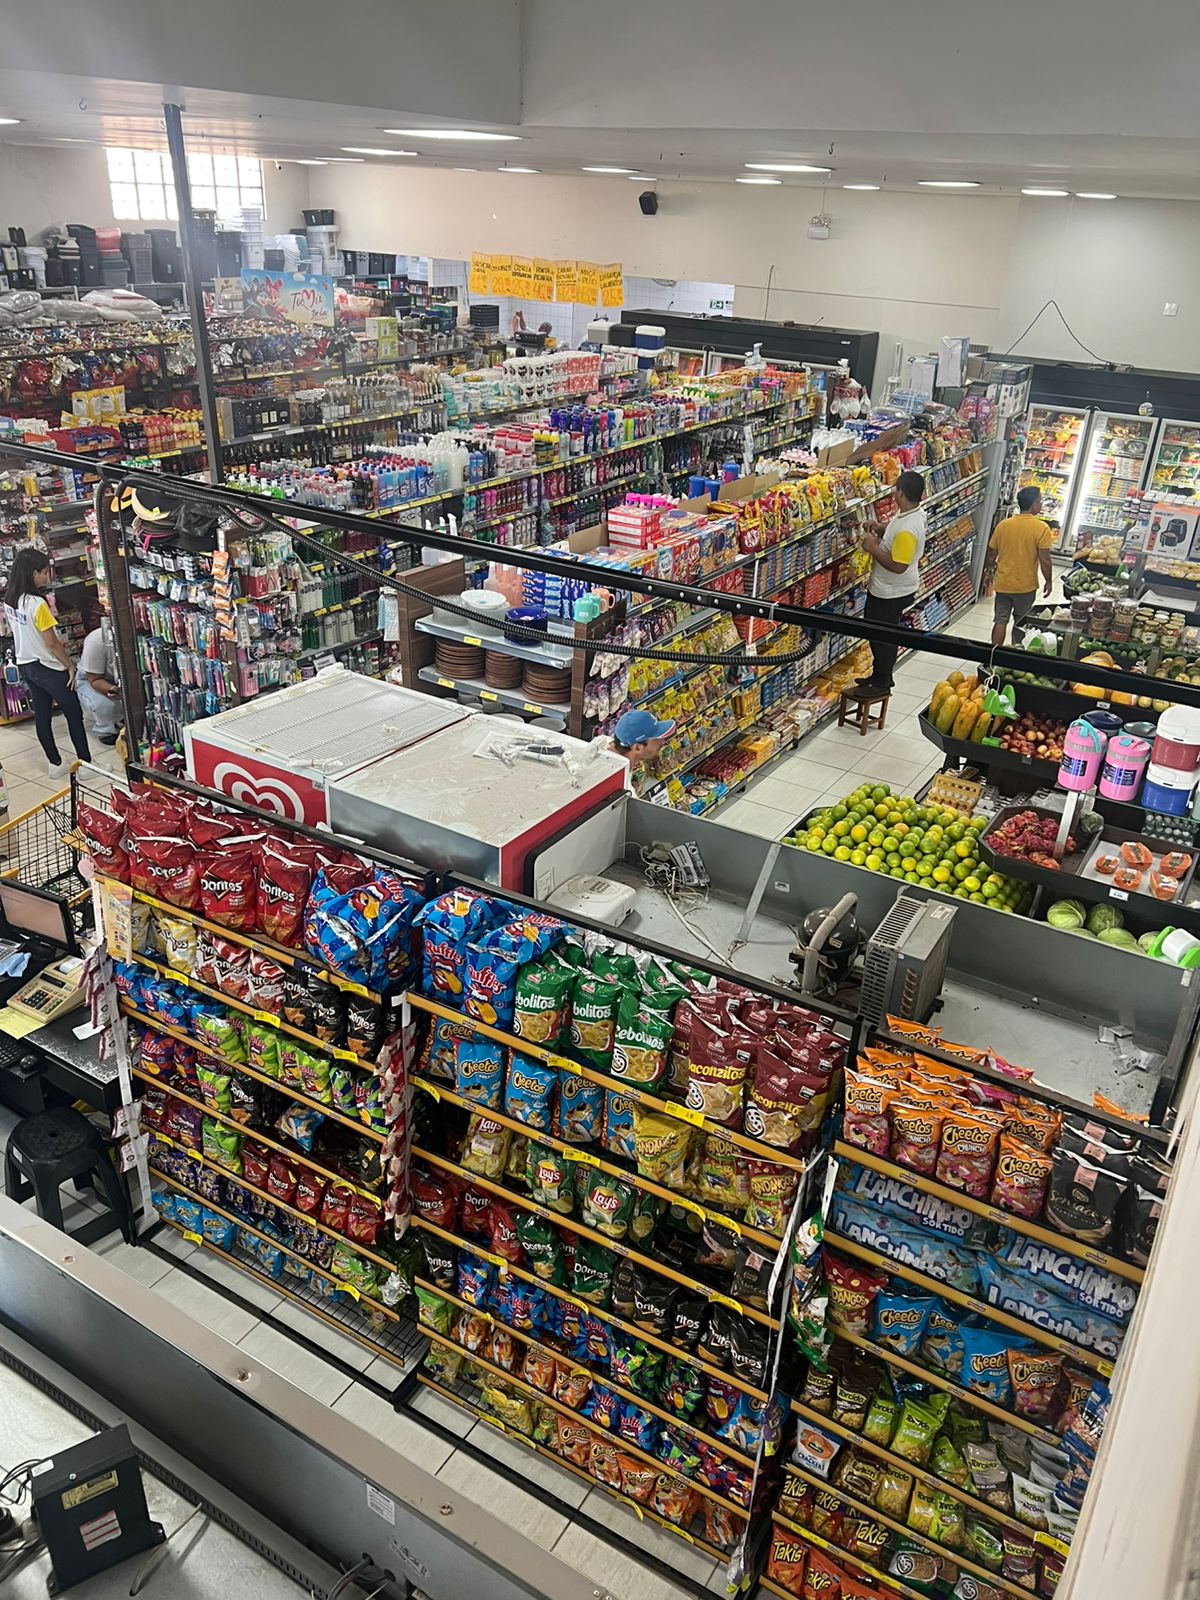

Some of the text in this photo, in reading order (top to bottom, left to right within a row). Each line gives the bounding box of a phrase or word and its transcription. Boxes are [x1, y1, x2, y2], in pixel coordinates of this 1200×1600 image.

[200, 878, 243, 892] Doritos
[260, 877, 295, 902] Doritos
[424, 939, 466, 967] Ruffles
[572, 1001, 612, 1019] bolitos
[460, 1058, 501, 1078] Cheetos
[511, 1070, 547, 1096] Cheetos
[845, 1085, 882, 1105] Cheetos
[943, 1126, 991, 1145] Cheetos
[538, 1167, 561, 1185] Lay's
[1000, 1156, 1048, 1179] Cheetos
[593, 1190, 618, 1210] Lay's
[855, 1169, 974, 1230] LANCHINHO
[922, 1217, 965, 1237] SORTIDO
[836, 1211, 947, 1280] LANCHINHO
[574, 1262, 608, 1279] Doritos
[1007, 1235, 1137, 1312] LANCHINHO
[832, 1289, 868, 1307] DANGOS
[1079, 1292, 1125, 1318] SORTIDO
[676, 1314, 700, 1329] ritos
[816, 1492, 841, 1513] akis
[855, 1520, 889, 1545] Takis
[773, 1541, 804, 1563] Takis
